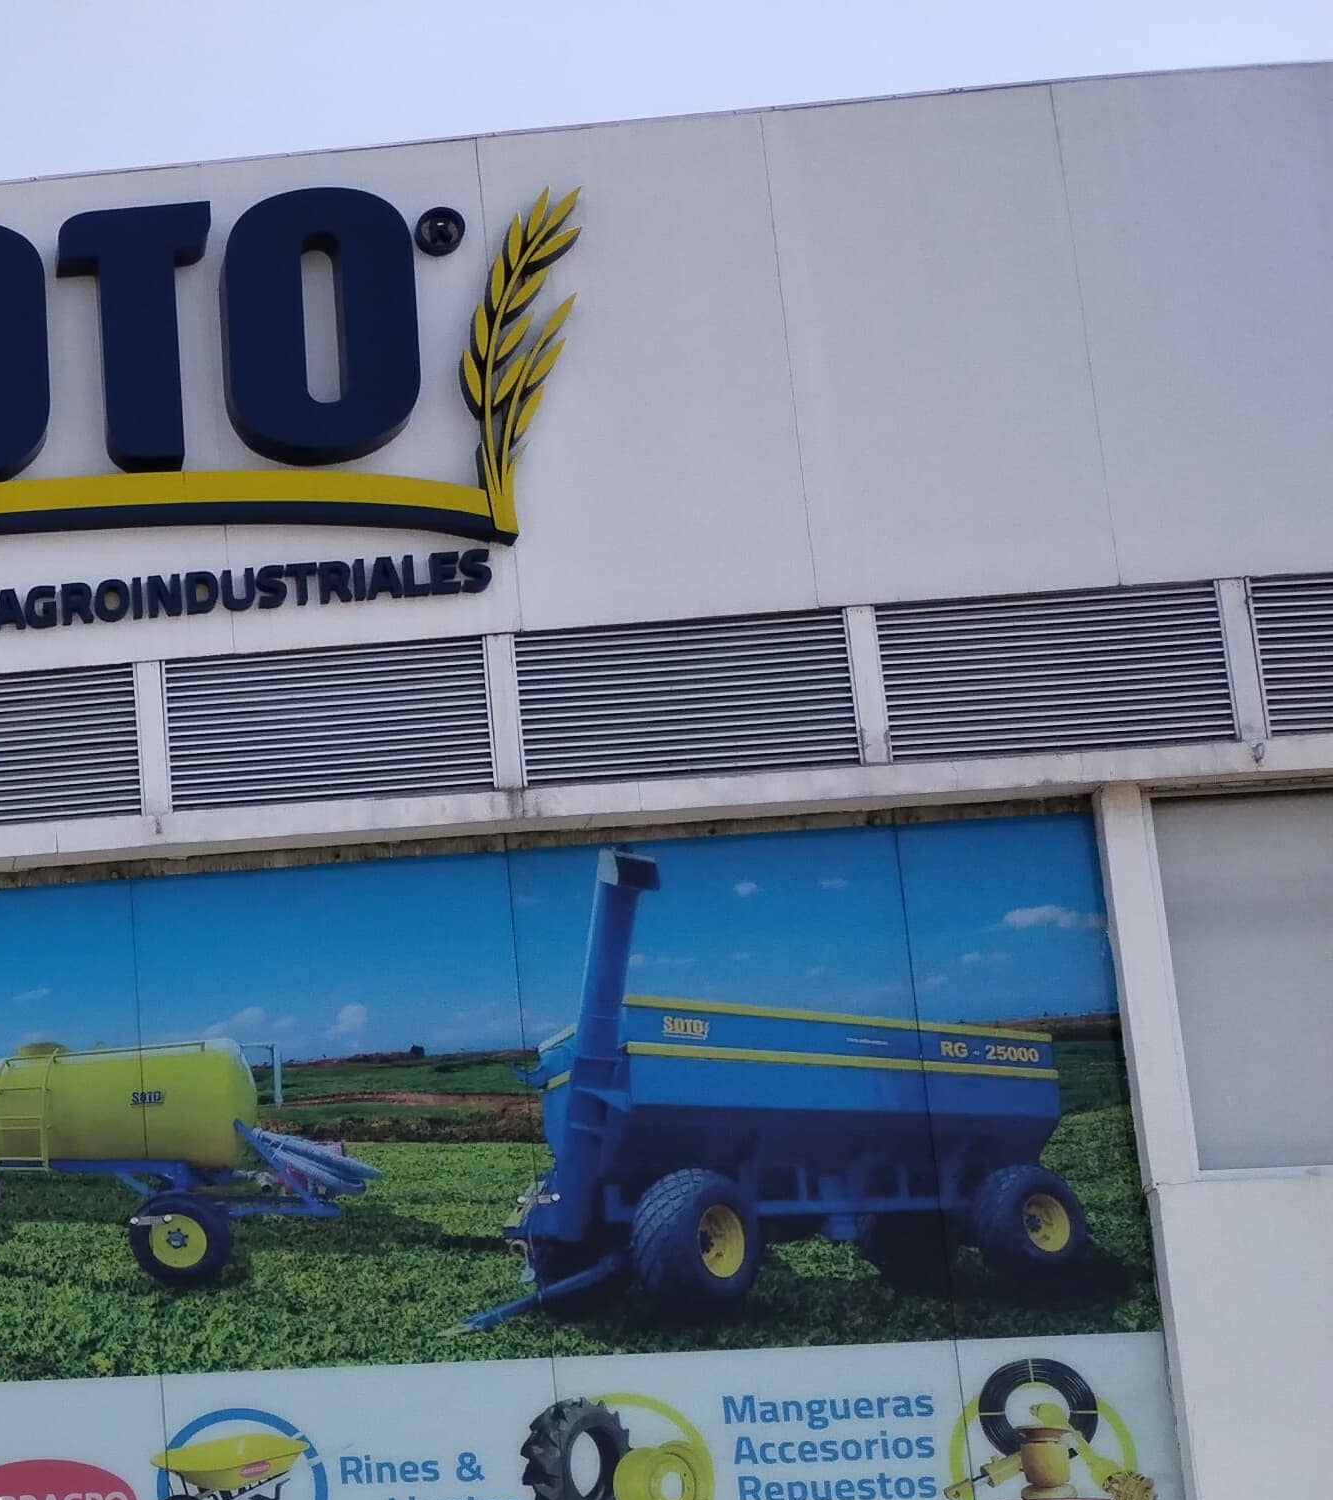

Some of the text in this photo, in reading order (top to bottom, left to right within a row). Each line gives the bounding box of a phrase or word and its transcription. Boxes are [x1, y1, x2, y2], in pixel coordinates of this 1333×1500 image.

[940, 1039, 969, 1058] RG
[985, 1043, 1040, 1063] 25000
[722, 1393, 935, 1431] Mangueras
[732, 1431, 936, 1466] Accesorios
[339, 1450, 487, 1486] Rines &
